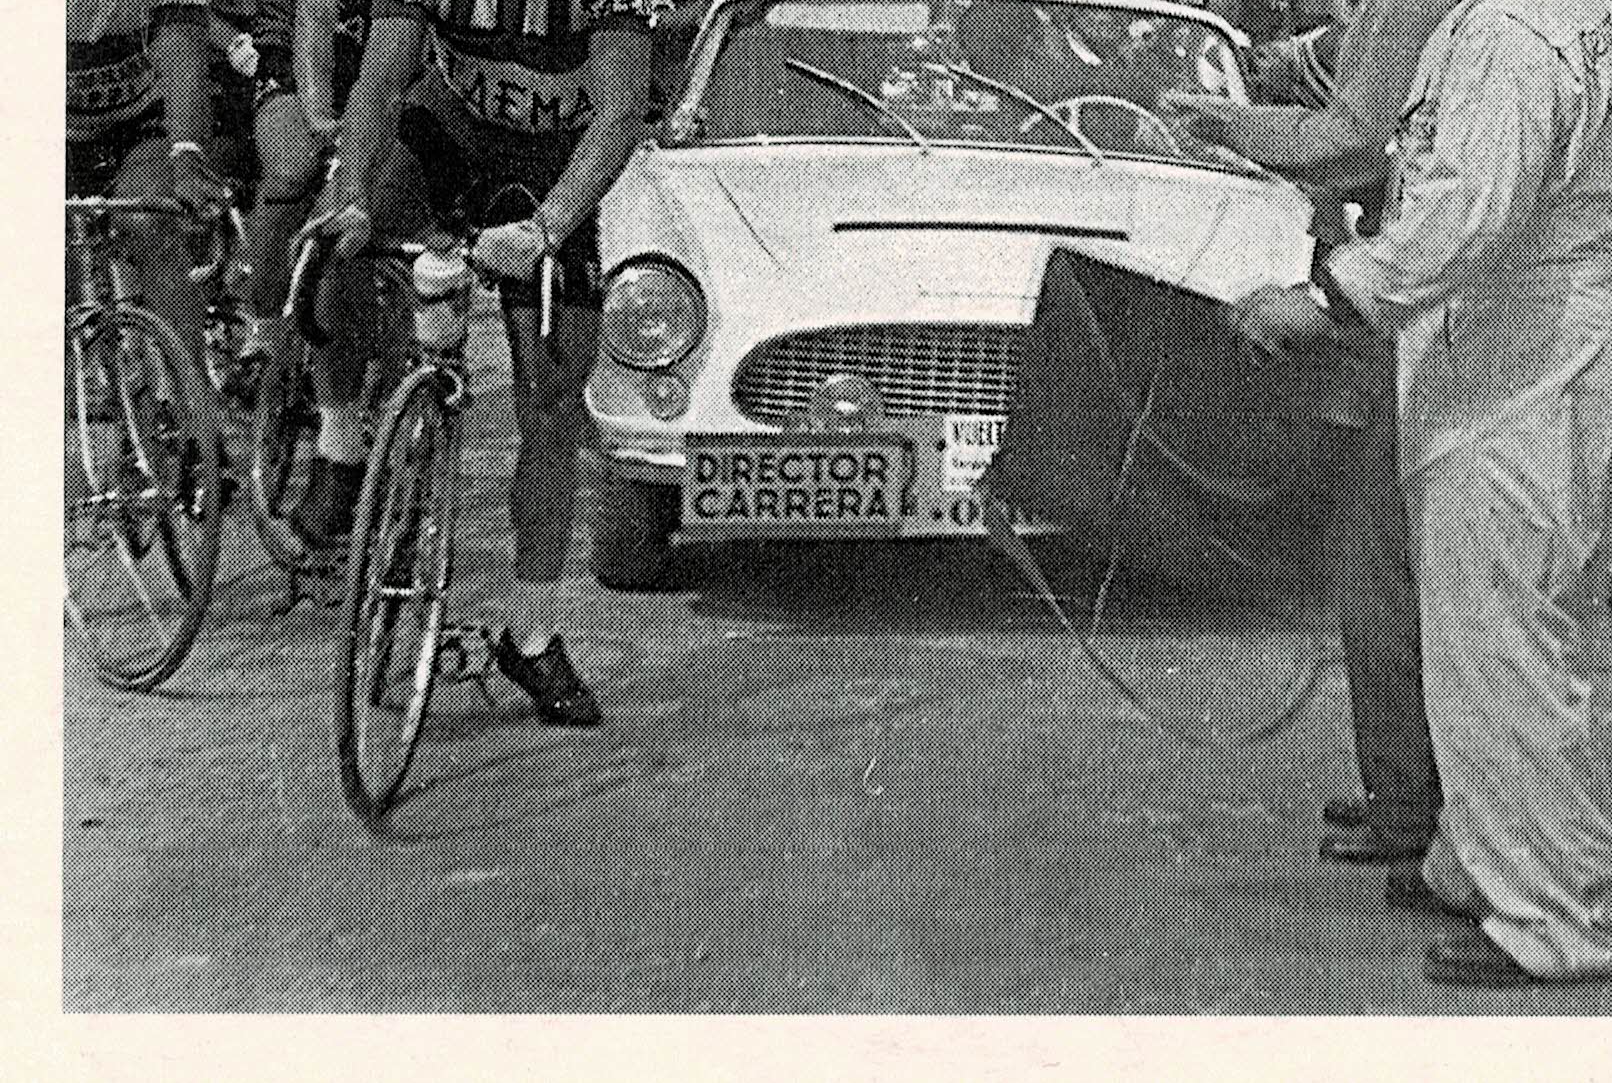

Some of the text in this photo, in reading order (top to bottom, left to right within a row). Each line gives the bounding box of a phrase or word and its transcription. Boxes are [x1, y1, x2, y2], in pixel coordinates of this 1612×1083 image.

[951, 421, 1004, 446] VUELT
[696, 452, 889, 486] DIRECTOR
[694, 487, 889, 519] CARRERA
